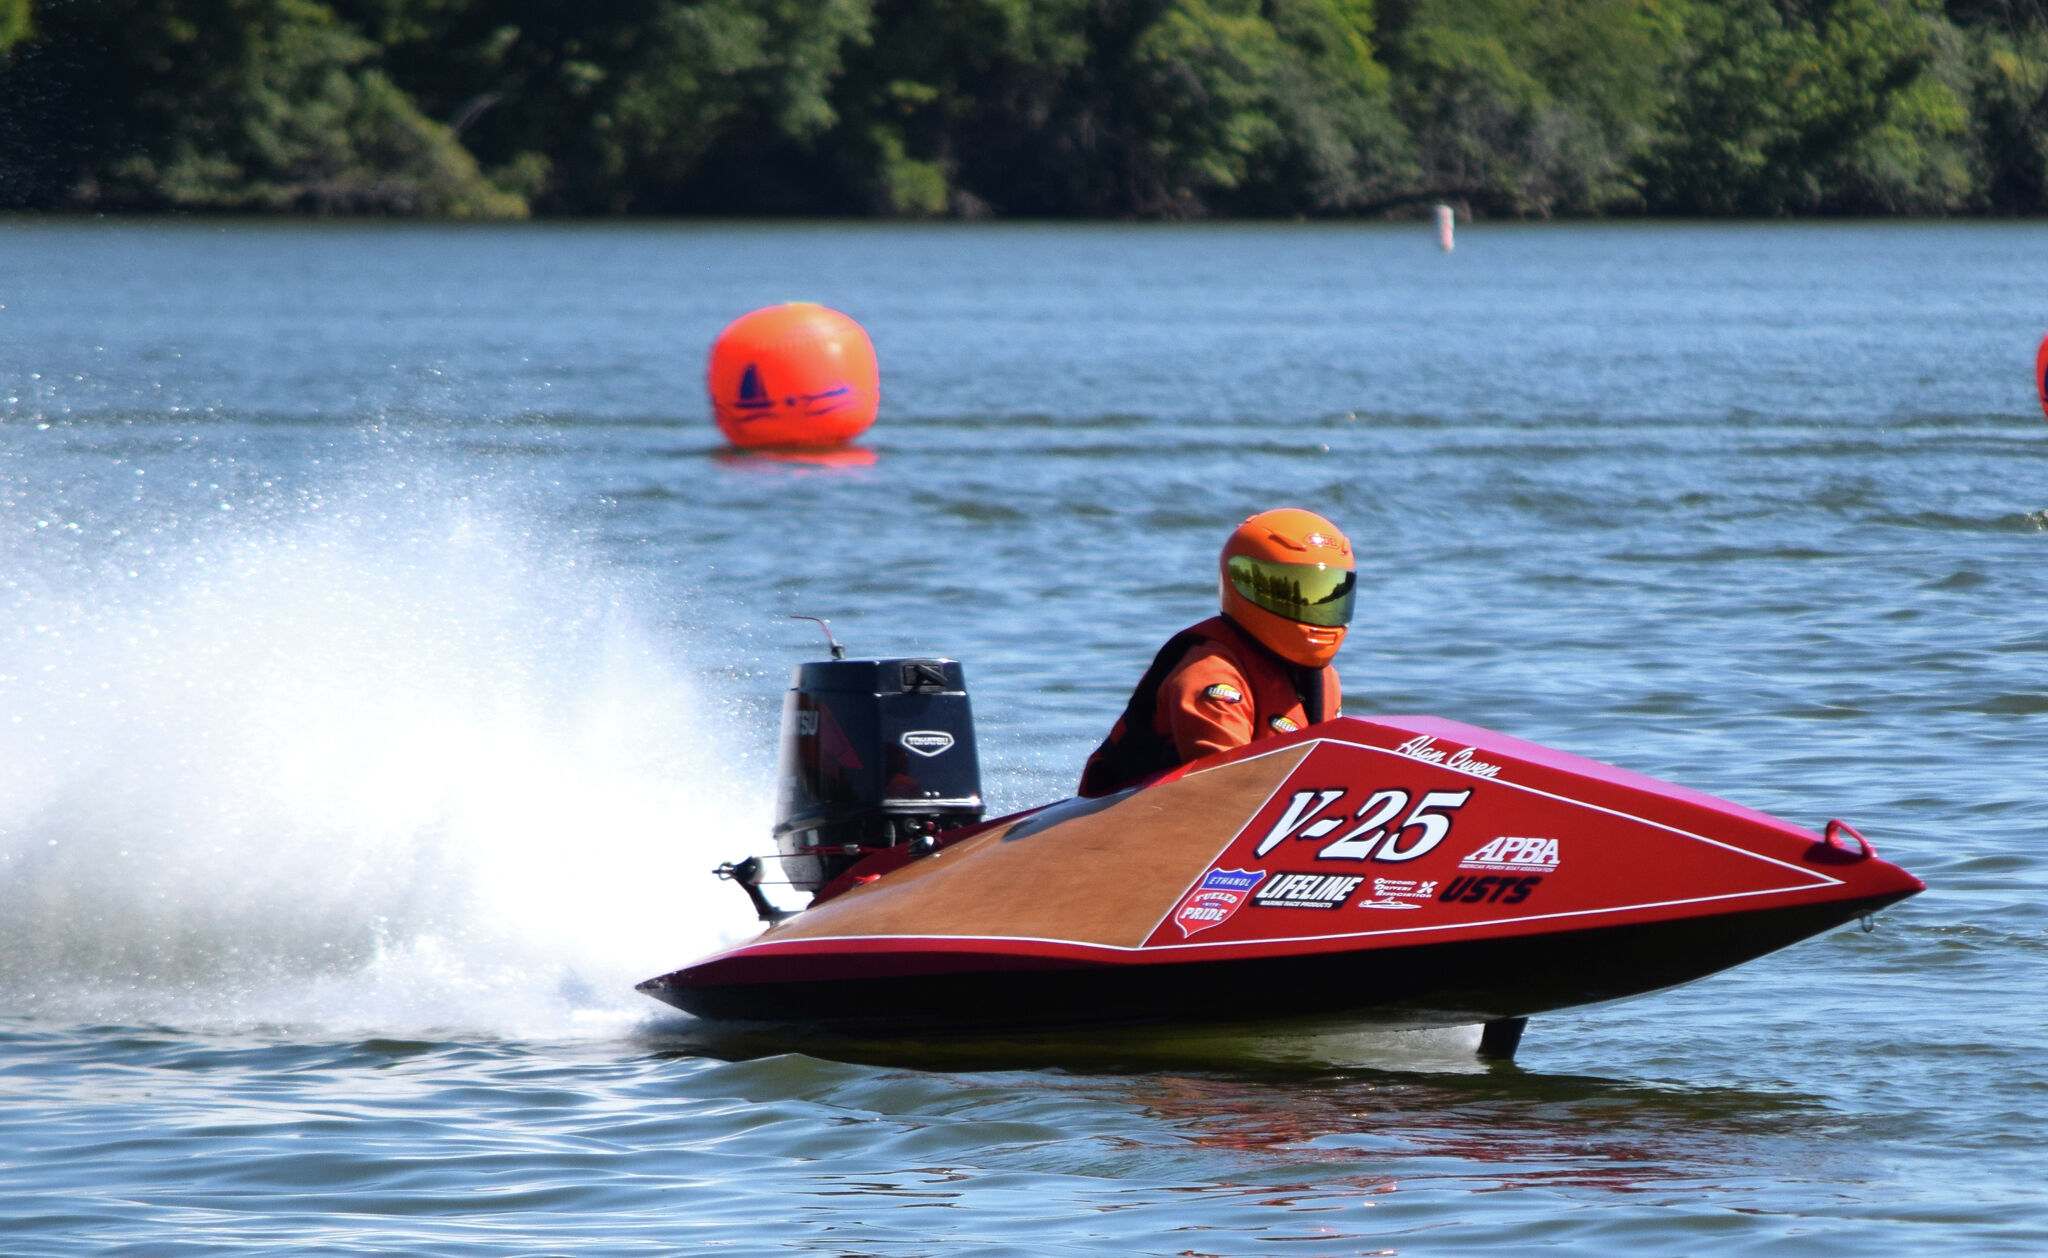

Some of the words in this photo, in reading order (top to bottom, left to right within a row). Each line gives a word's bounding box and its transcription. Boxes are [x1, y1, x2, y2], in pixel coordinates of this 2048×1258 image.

[1394, 734, 1447, 763] Alan
[1446, 747, 1503, 777] Owen
[1254, 787, 1475, 863] V-25
[1462, 836, 1561, 864] APBA
[1208, 876, 1252, 887] ETHANOL
[1255, 873, 1365, 902] LIFELINE
[1438, 876, 1543, 904] USTS
[1194, 892, 1238, 904] FUELED
[1180, 907, 1228, 921] PRIDE
